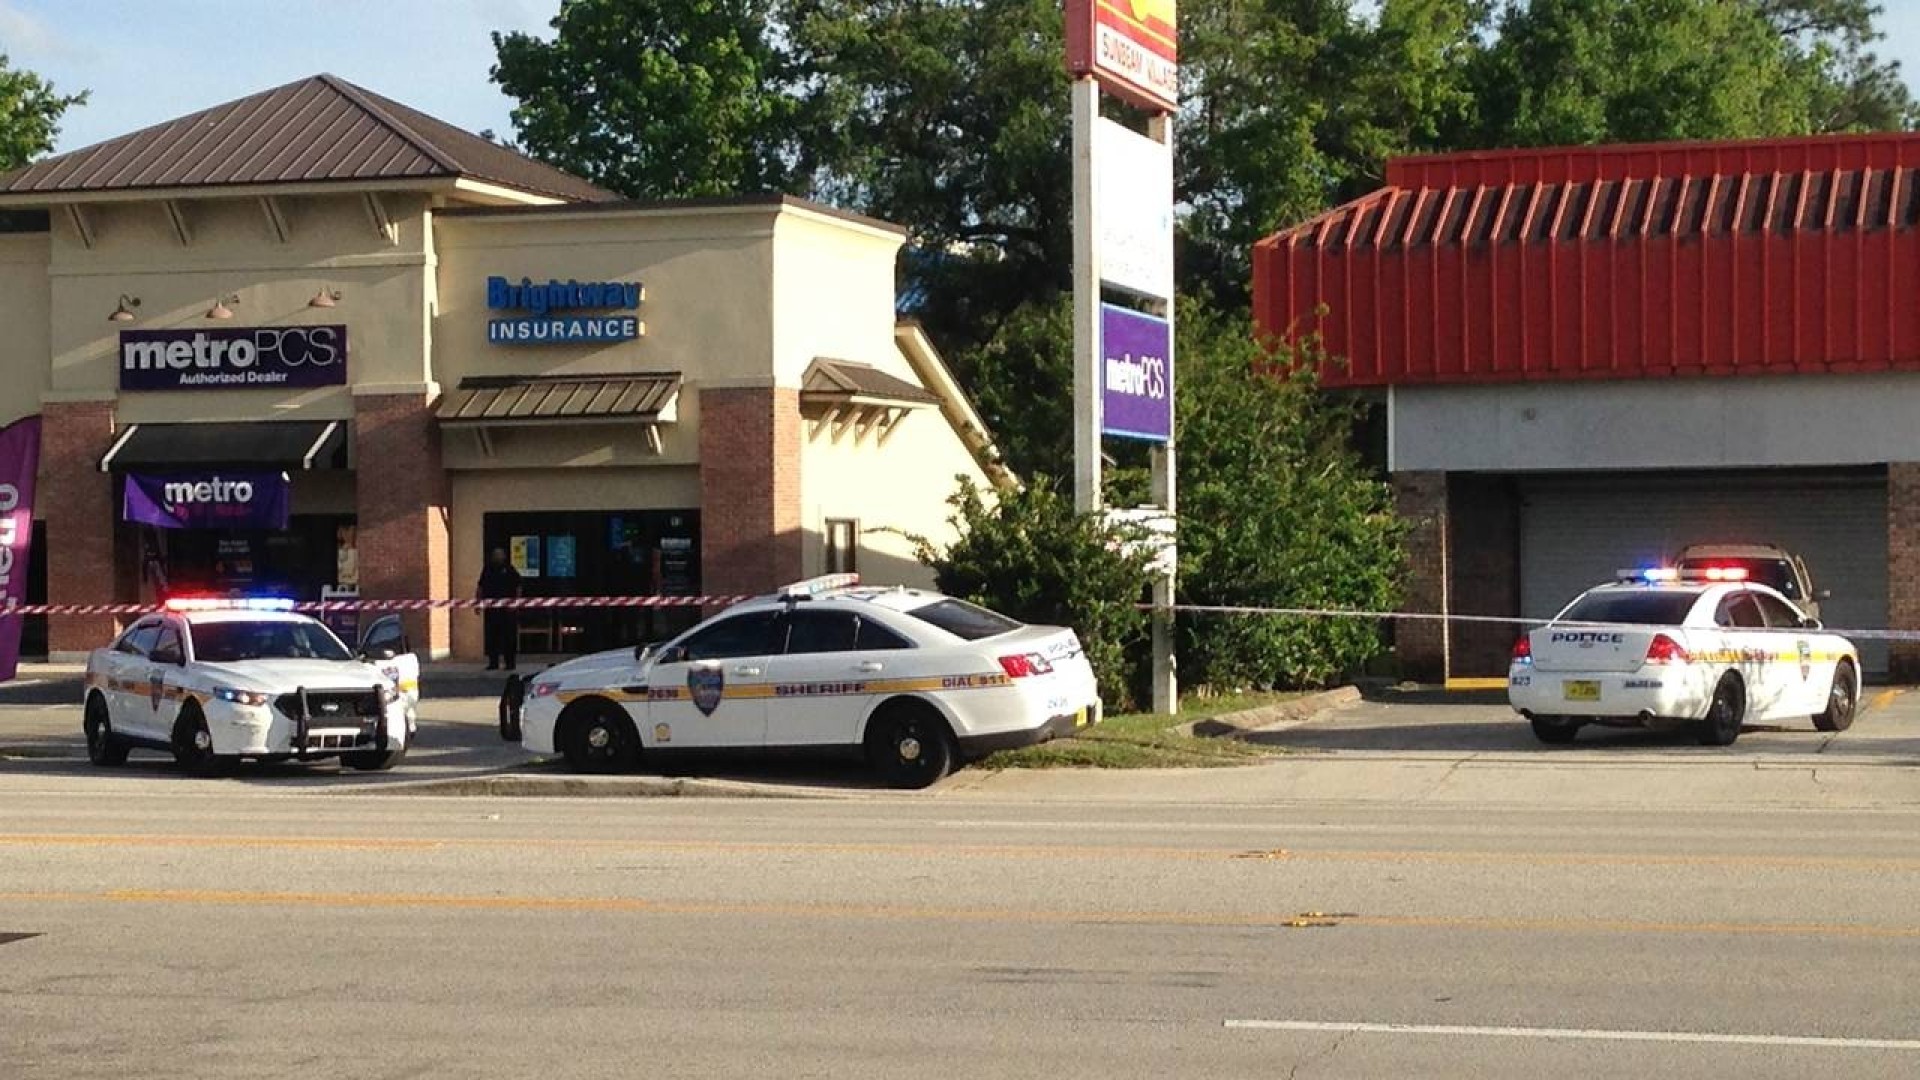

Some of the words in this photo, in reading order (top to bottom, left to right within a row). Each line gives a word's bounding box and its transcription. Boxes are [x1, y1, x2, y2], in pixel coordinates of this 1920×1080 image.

[1103, 32, 1143, 74] SUNBEAM
[488, 276, 643, 313] Brightway
[491, 320, 636, 340] INSURANCE
[124, 328, 338, 369] metroPCS
[180, 371, 245, 385] Authorized
[247, 371, 288, 383] Dealer
[1106, 353, 1165, 399] metroPCS
[164, 476, 253, 503] metro
[1551, 632, 1624, 643] POLICE
[775, 683, 866, 695] SHERIFF
[942, 674, 973, 687] DIAL
[979, 674, 1005, 685] 911
